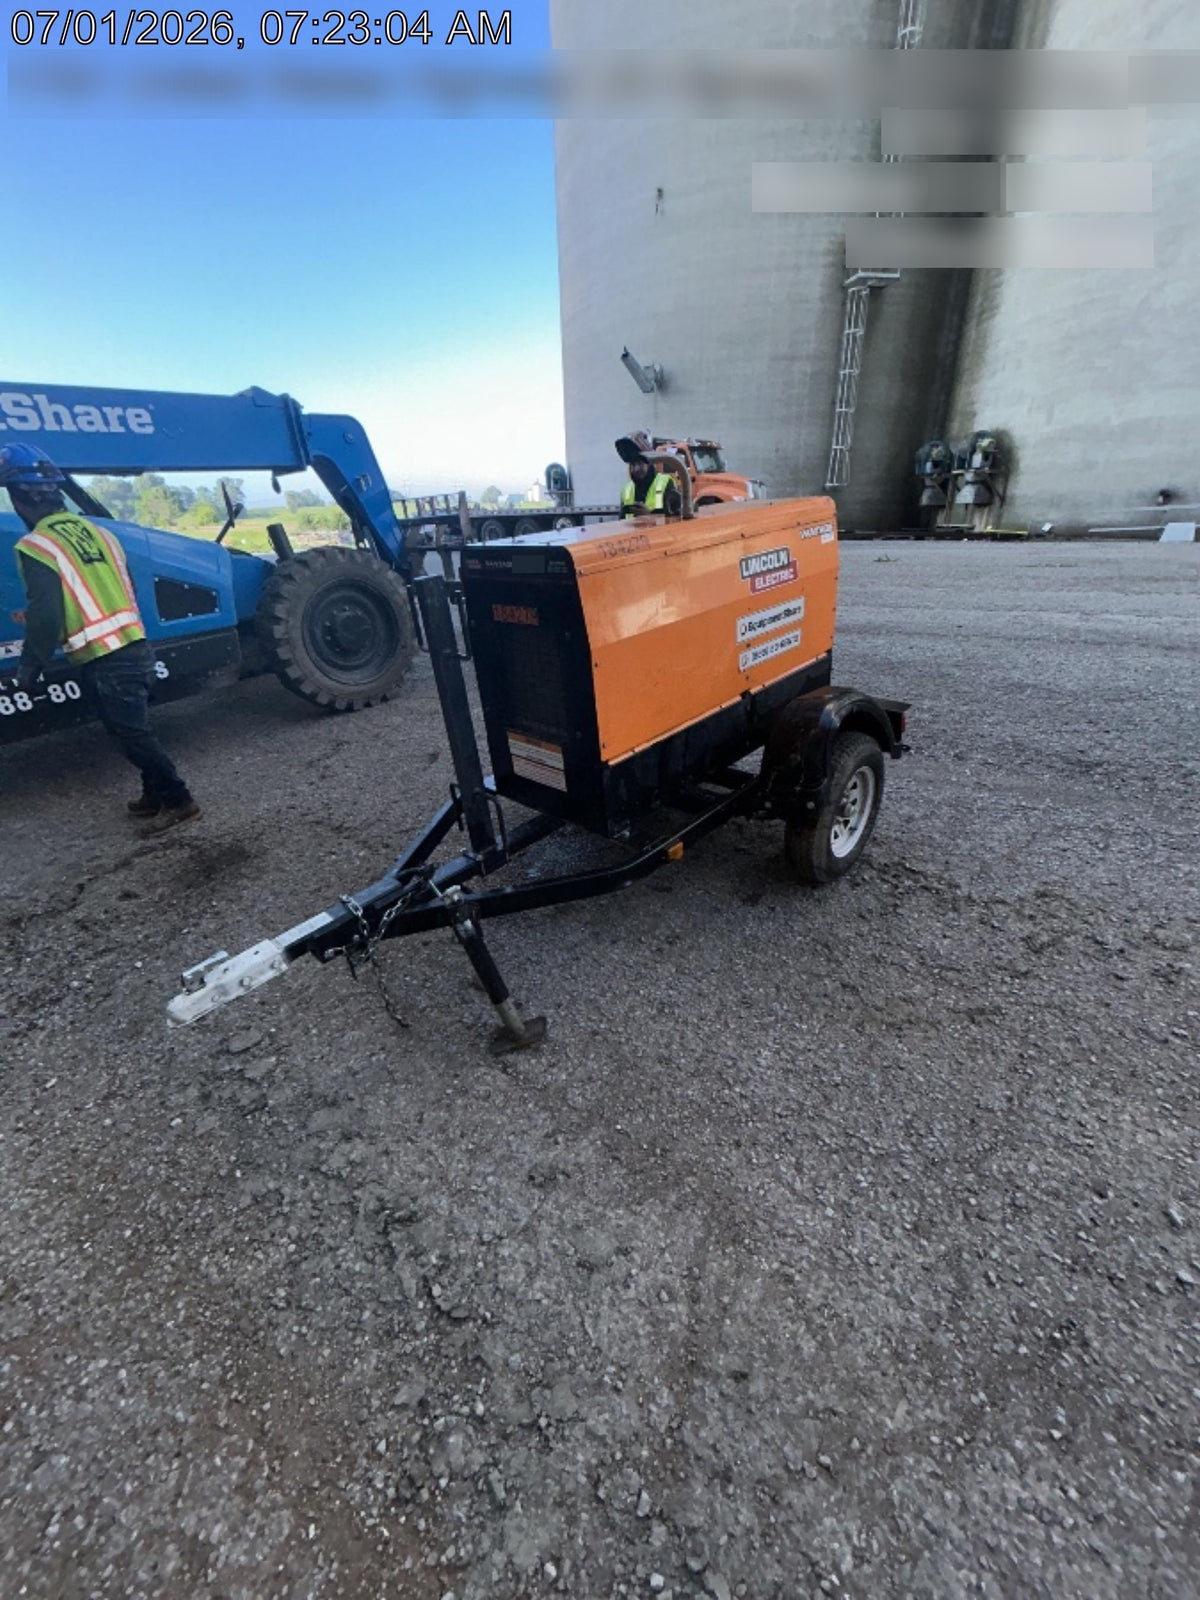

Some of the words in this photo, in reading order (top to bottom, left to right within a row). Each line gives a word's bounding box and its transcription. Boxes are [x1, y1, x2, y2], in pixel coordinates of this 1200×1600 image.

[0, 391, 156, 435] Share
[741, 549, 789, 577] LINCOLN
[755, 567, 794, 590] ELECTRIC
